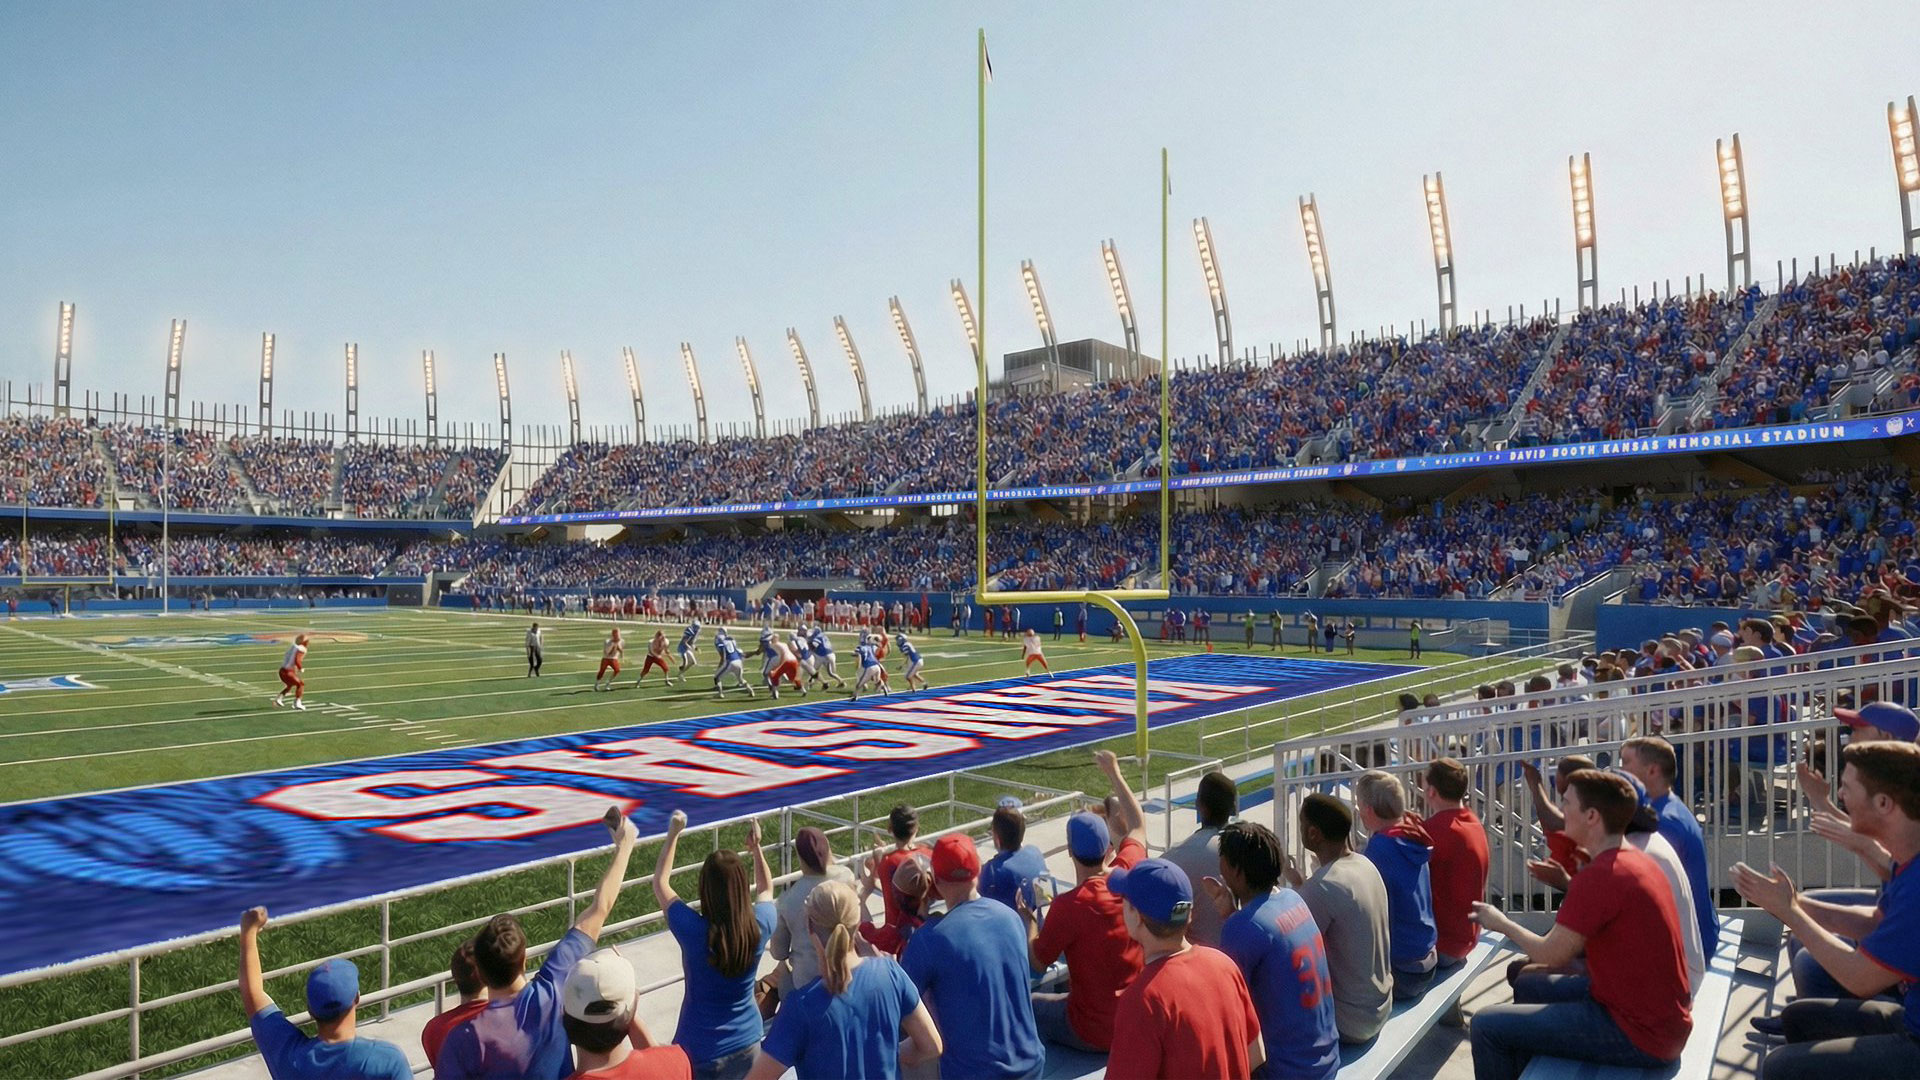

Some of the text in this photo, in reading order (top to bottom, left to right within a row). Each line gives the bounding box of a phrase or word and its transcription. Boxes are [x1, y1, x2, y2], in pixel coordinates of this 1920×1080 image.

[1509, 447, 1546, 461] DAVID
[1552, 444, 1595, 458] BOOTH
[1602, 440, 1659, 454] KANSAS
[1668, 433, 1753, 449] MEMORIAL
[1762, 426, 1845, 443] STADIUM
[1294, 467, 1329, 478] STADIUM
[898, 495, 922, 503] DAVID
[993, 488, 1037, 498] MEMORIAL
[1041, 487, 1080, 496] STADIUM
